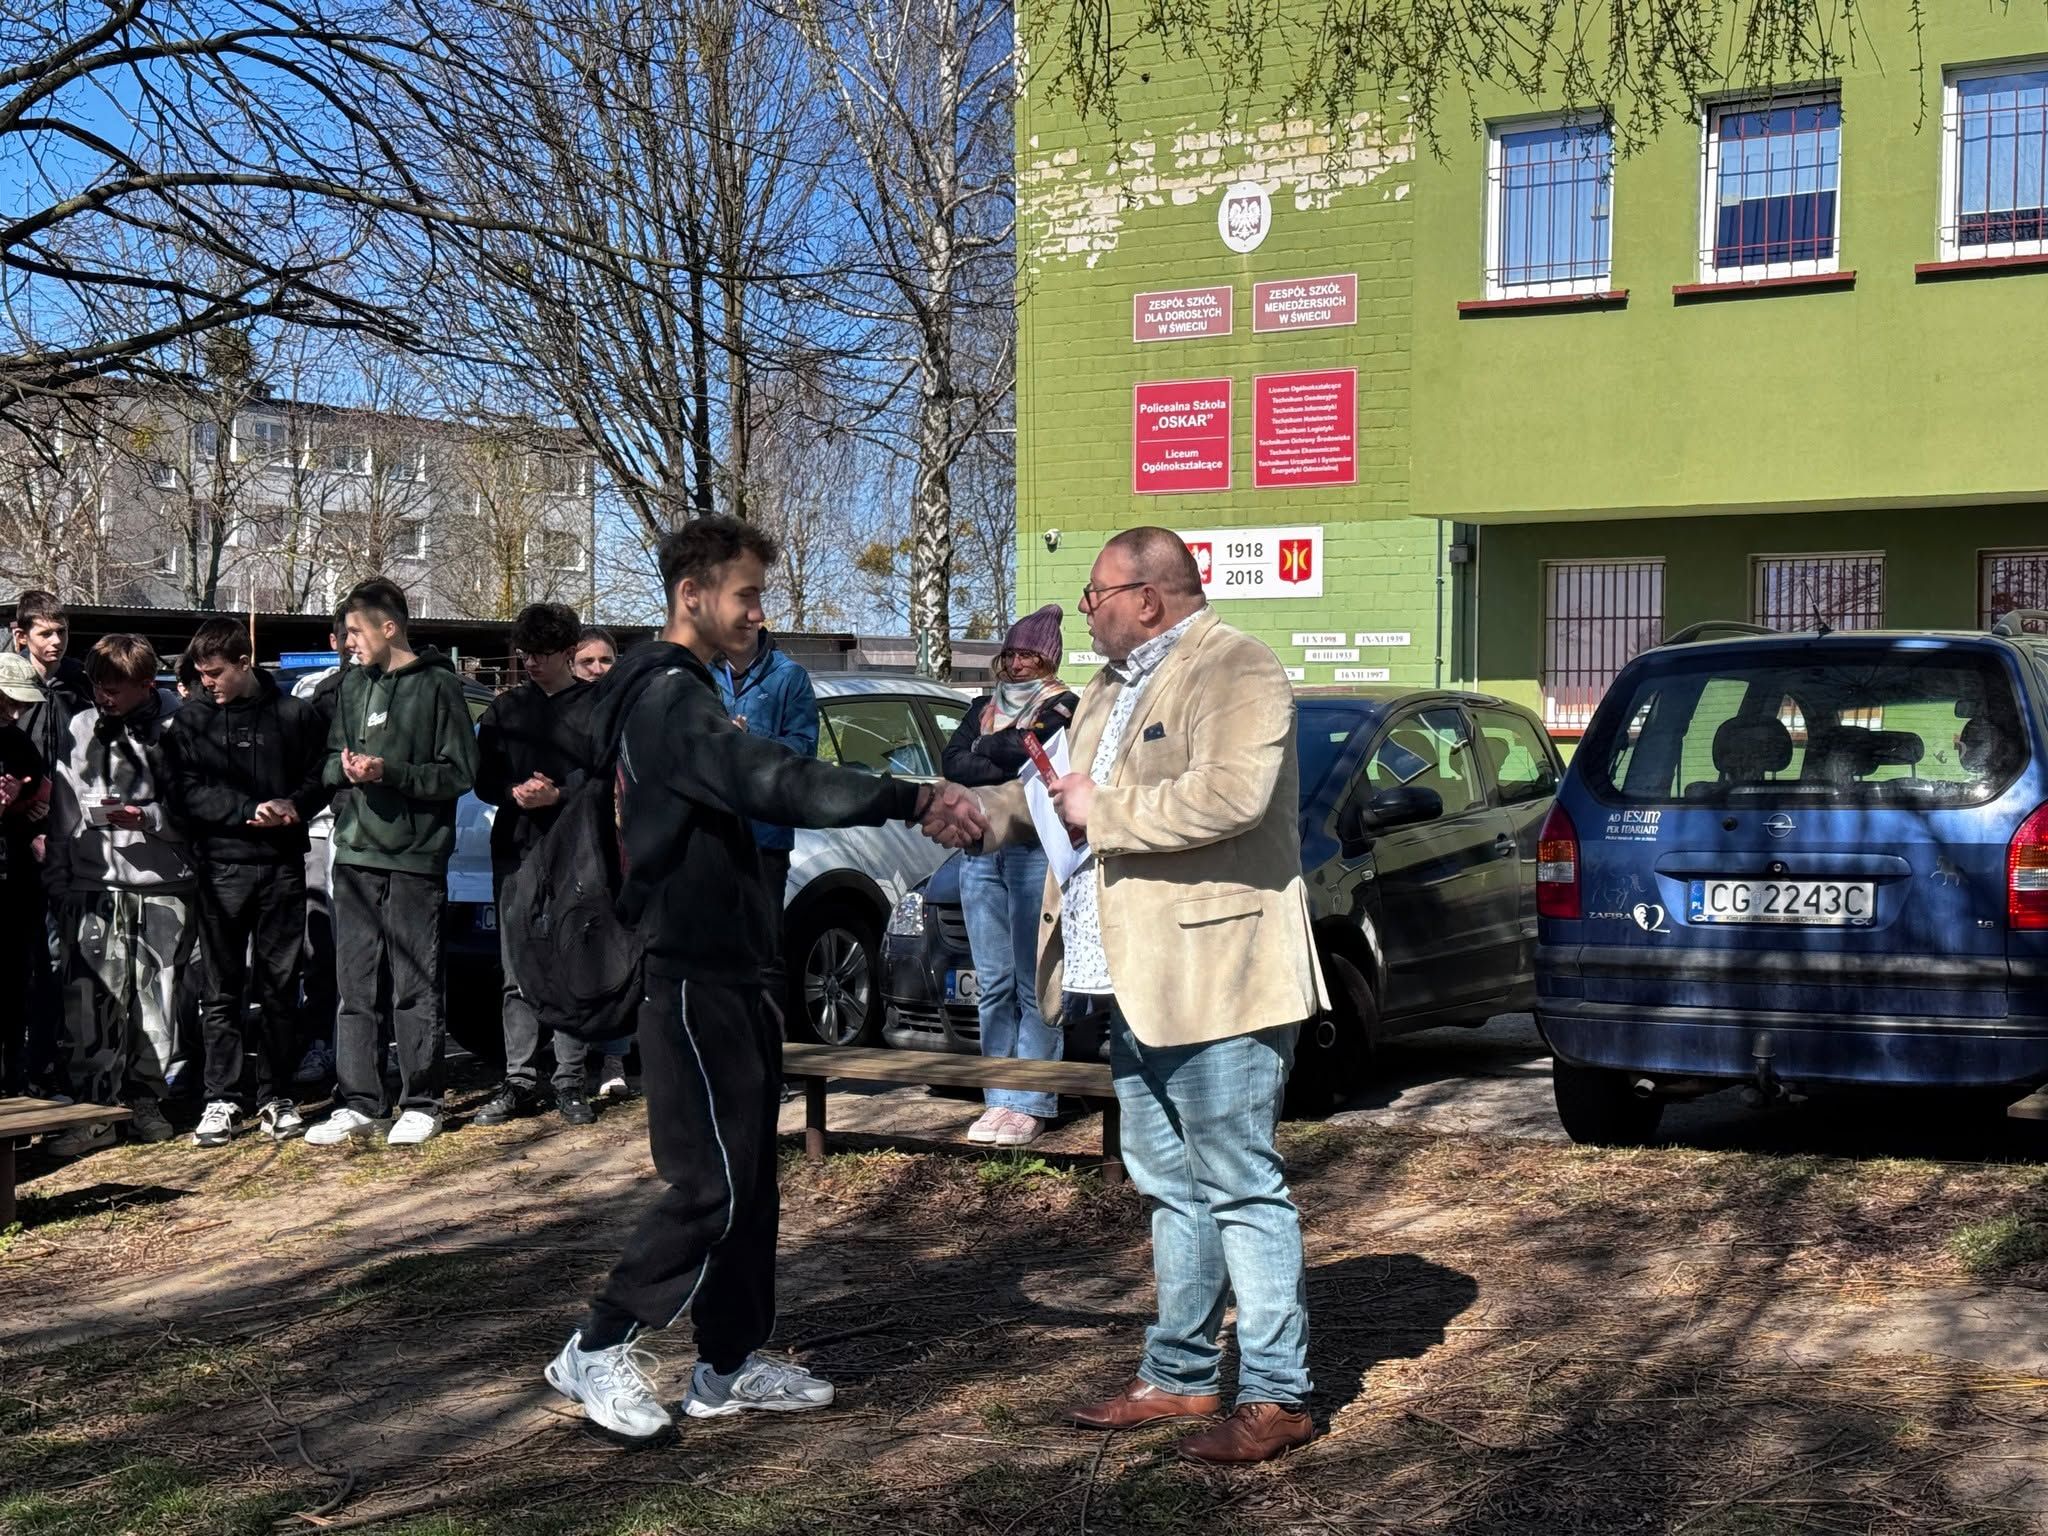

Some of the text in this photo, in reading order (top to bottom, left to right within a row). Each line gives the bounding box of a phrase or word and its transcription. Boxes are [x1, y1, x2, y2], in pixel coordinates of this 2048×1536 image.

[1269, 282, 1342, 299] ZESPÓŁ SZKÓŁ
[1148, 293, 1218, 311] ZESPÓŁ SZKÓŁ
[1264, 295, 1346, 313] MENEDŻERSKICH
[1144, 307, 1222, 323] DLA DOROSŁYCH
[1279, 310, 1331, 324] W ŚWIECIU
[1158, 320, 1208, 334] W ŚWIECIU
[1140, 402, 1190, 413] Policealna
[1165, 449, 1199, 459] Liceum
[1226, 542, 1263, 559] 1918
[1225, 569, 1264, 586] 2018
[1607, 813, 1621, 822] AD
[1692, 902, 1702, 910] PL
[1711, 883, 1864, 915] CG 2243C
[1588, 911, 1633, 920] ZAFIRA
